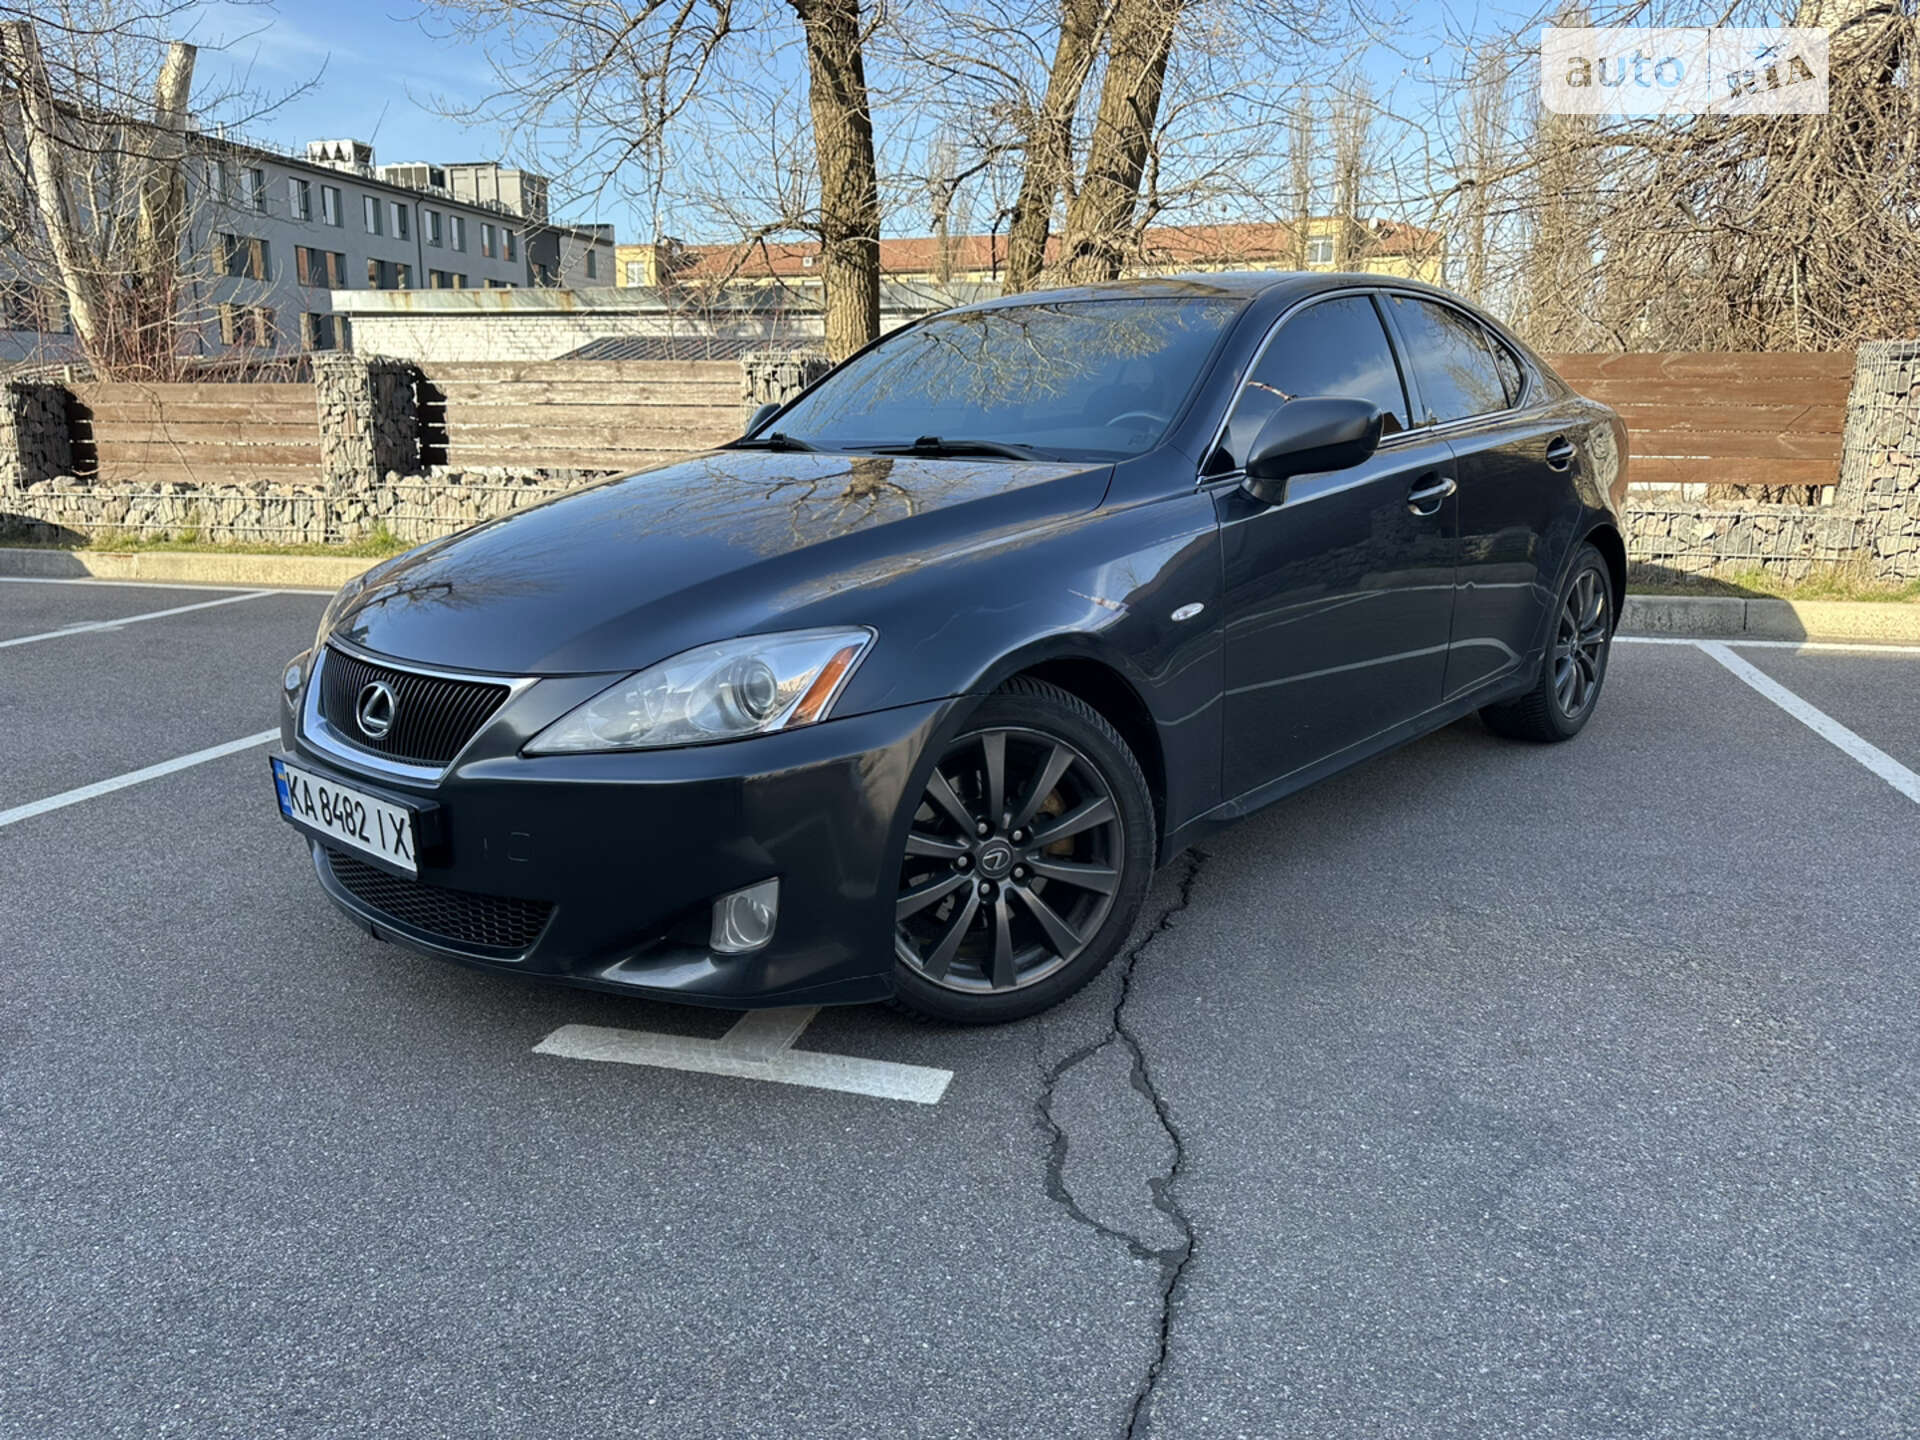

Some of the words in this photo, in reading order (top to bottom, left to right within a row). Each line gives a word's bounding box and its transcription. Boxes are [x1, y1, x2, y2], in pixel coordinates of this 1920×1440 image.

[286, 772, 318, 821] KA
[319, 787, 370, 843] 8482
[377, 809, 411, 860] IX
